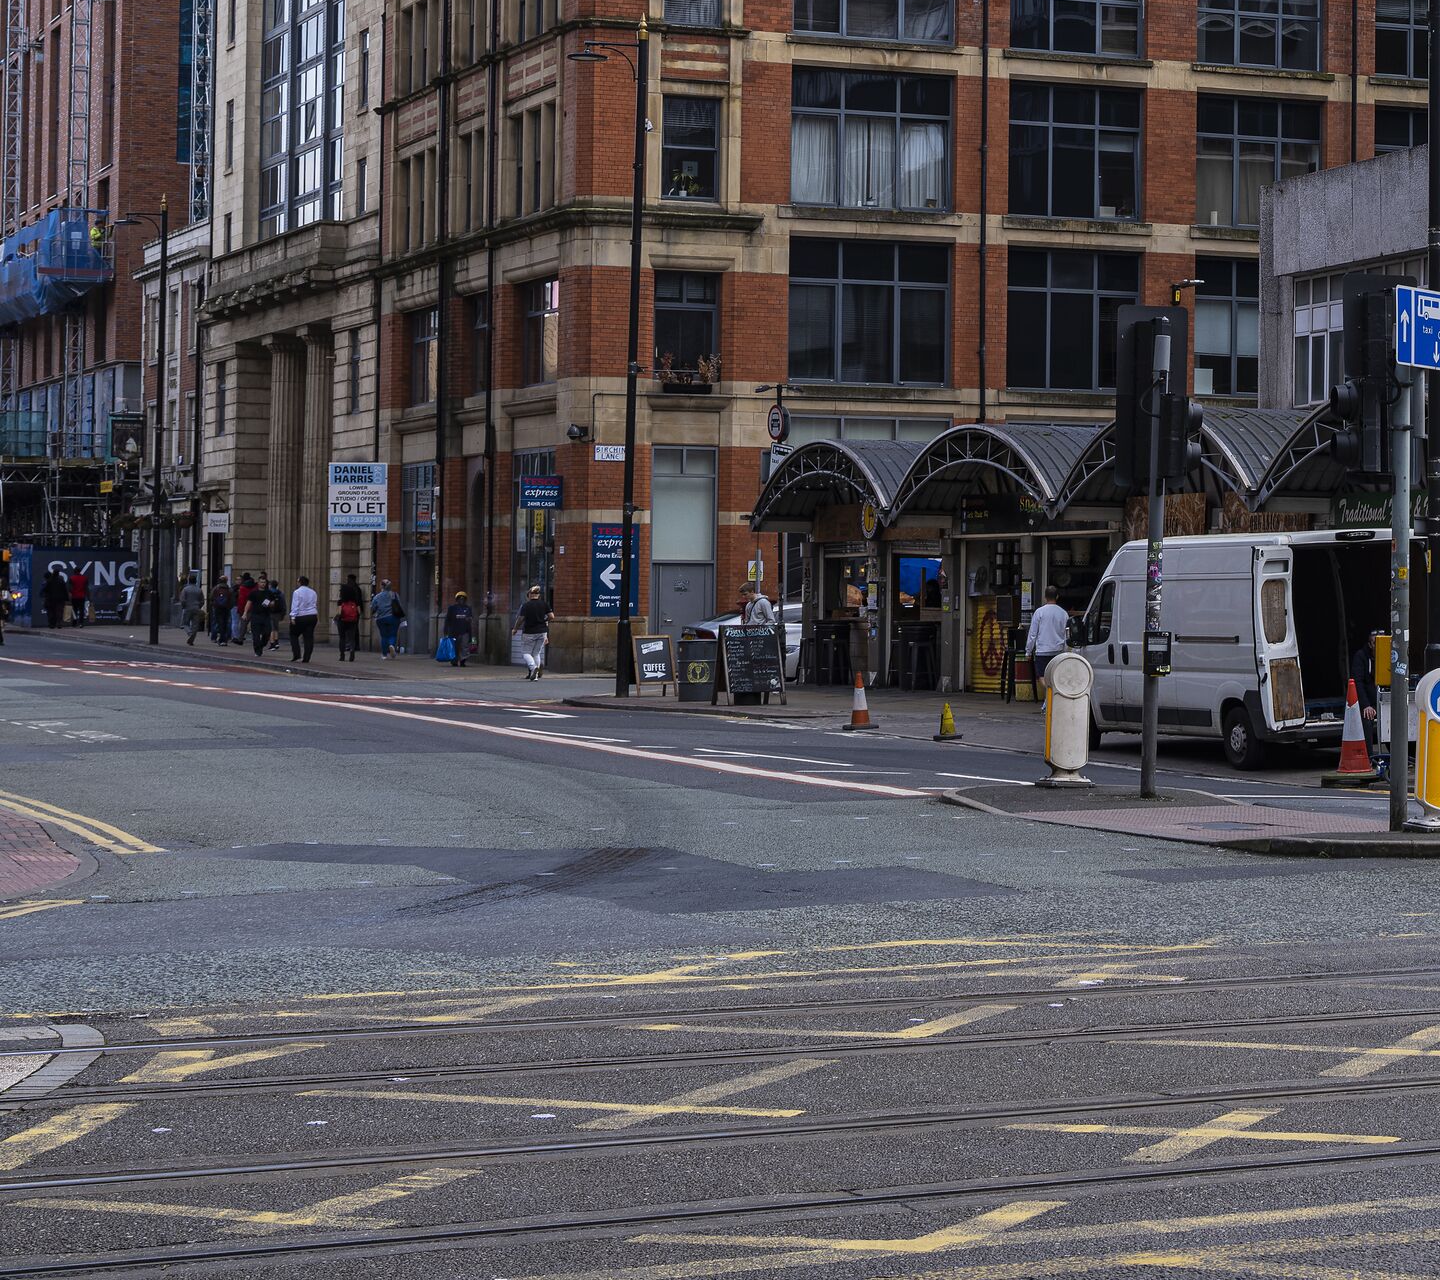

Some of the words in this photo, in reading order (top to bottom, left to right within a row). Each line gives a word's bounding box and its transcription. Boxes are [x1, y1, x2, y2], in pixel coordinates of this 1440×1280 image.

[1422, 325, 1433, 335] taxi
[334, 465, 373, 474] DANIEL
[334, 475, 374, 483] HARRIS
[524, 477, 560, 486] TESCO
[525, 489, 558, 498] express
[330, 502, 351, 514] TO
[357, 502, 386, 514] LET
[1339, 498, 1388, 524] Traditional
[642, 663, 666, 672] COFFEE
